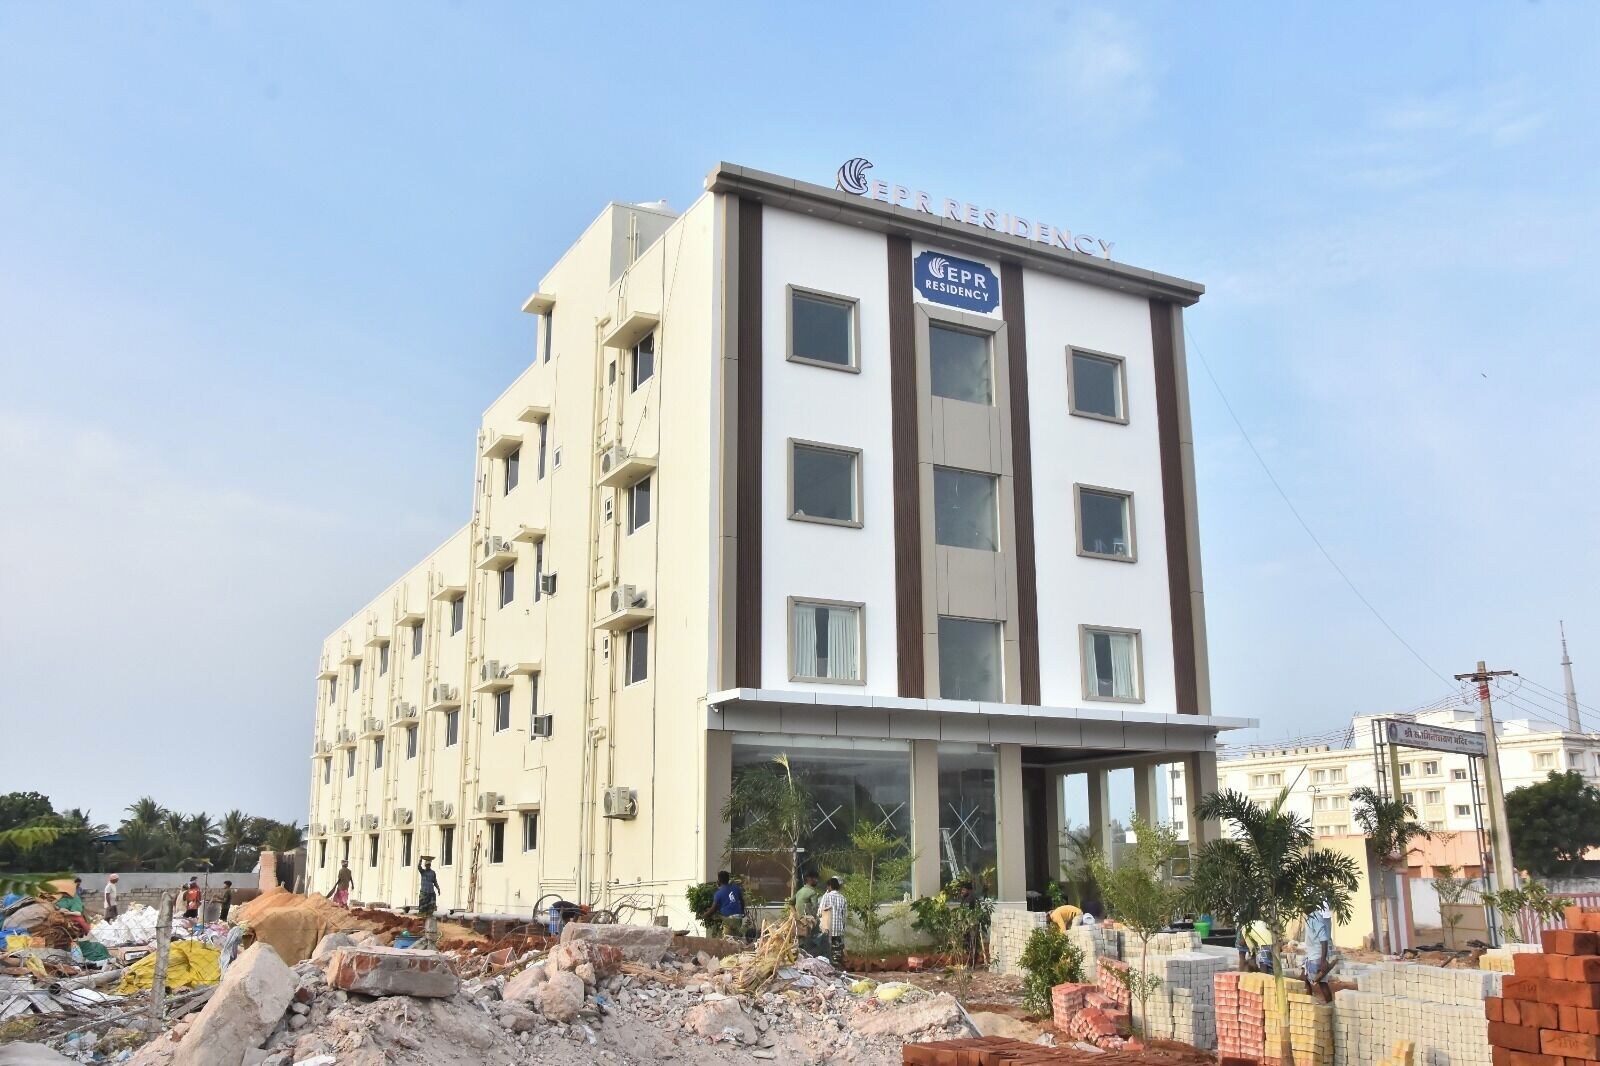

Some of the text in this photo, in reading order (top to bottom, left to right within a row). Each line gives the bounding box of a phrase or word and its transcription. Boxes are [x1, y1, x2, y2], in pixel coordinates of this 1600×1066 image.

[872, 179, 1116, 260] EPR RESIDENCY
[947, 267, 987, 289] EPR
[925, 279, 989, 302] RESIDENCY
